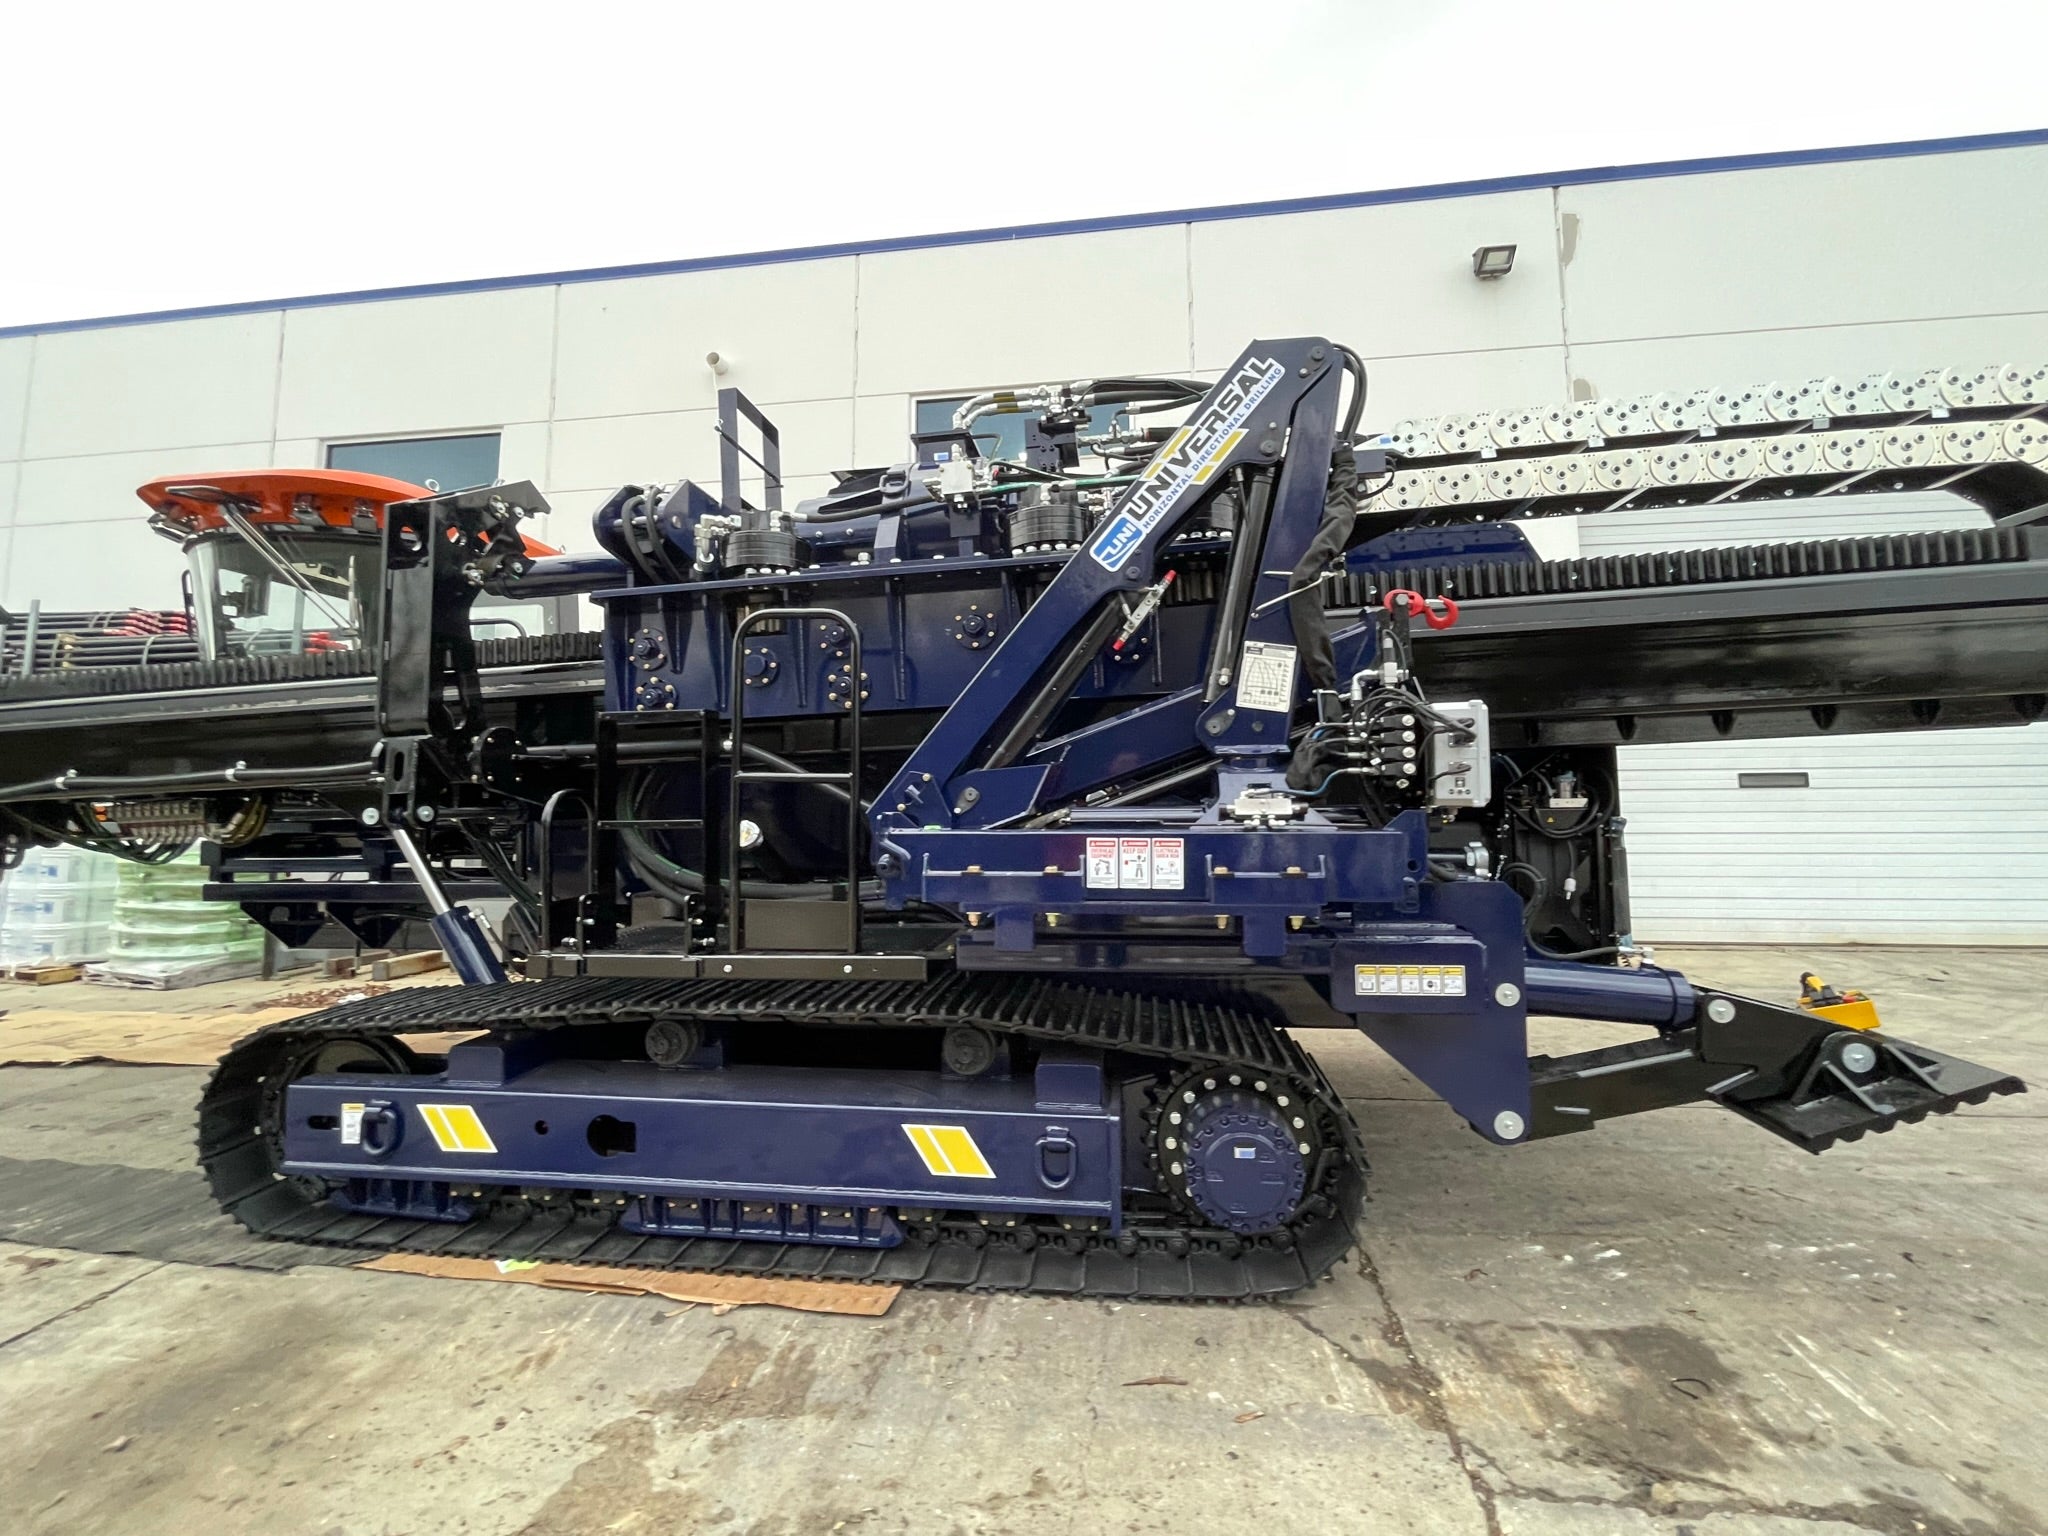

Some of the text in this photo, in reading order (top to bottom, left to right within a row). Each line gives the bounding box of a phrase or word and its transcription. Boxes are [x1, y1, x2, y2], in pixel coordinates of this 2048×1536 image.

[1125, 359, 1275, 521] UNIVERSAL
[1142, 366, 1282, 530] HORIZONTAL DIRECTIONAL DRILLING
[1102, 521, 1137, 557] UNI
